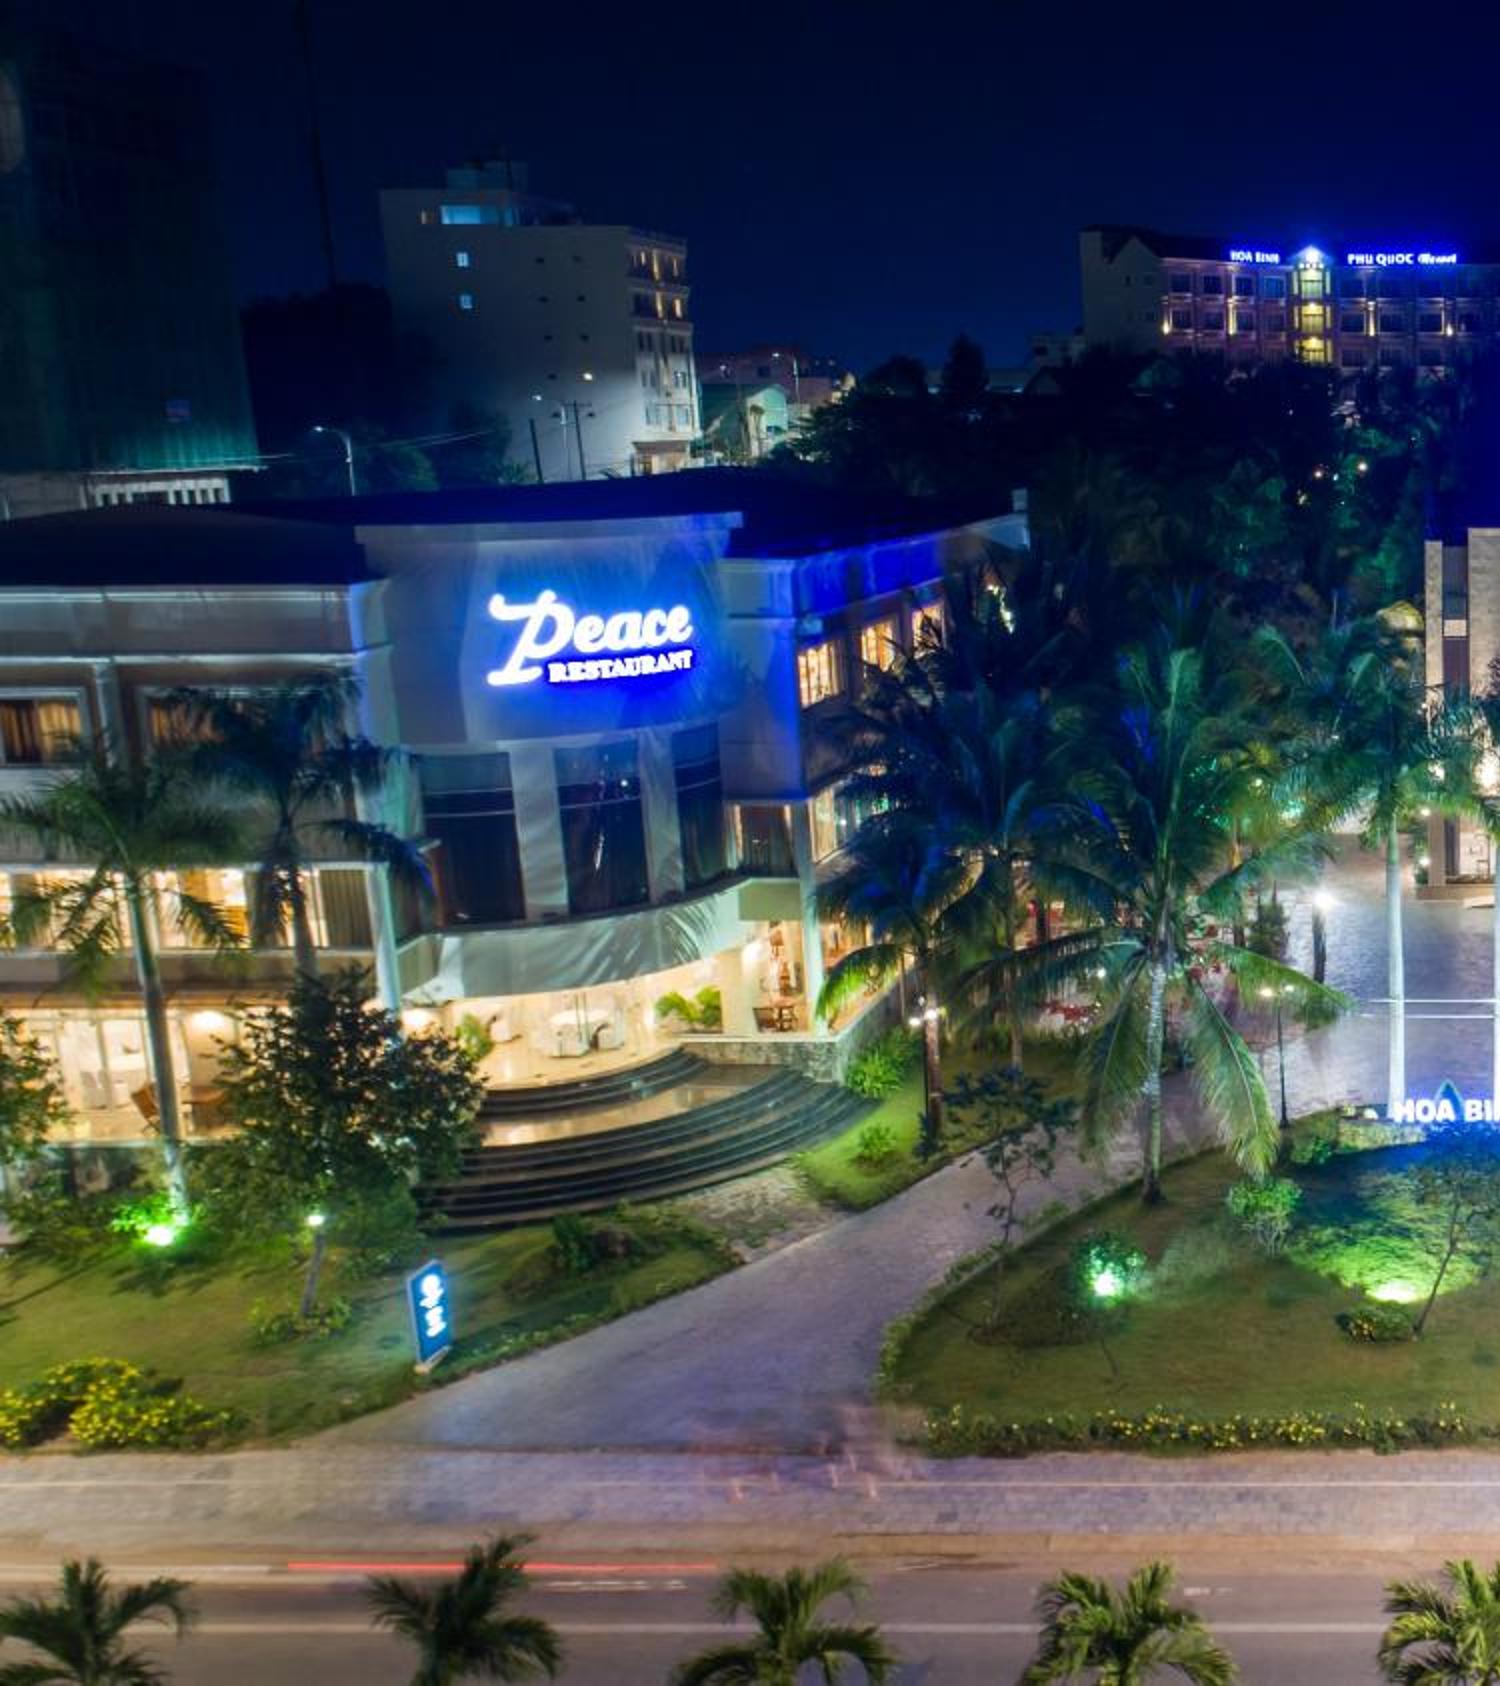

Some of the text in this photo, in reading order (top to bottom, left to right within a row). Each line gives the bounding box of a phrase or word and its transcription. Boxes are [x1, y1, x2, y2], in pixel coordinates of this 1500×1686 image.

[1347, 253, 1374, 265] PHU
[1376, 253, 1415, 266] QUOC
[487, 589, 693, 686] Peace
[548, 650, 693, 683] RESTAURANT
[1394, 1098, 1455, 1122] HOA
